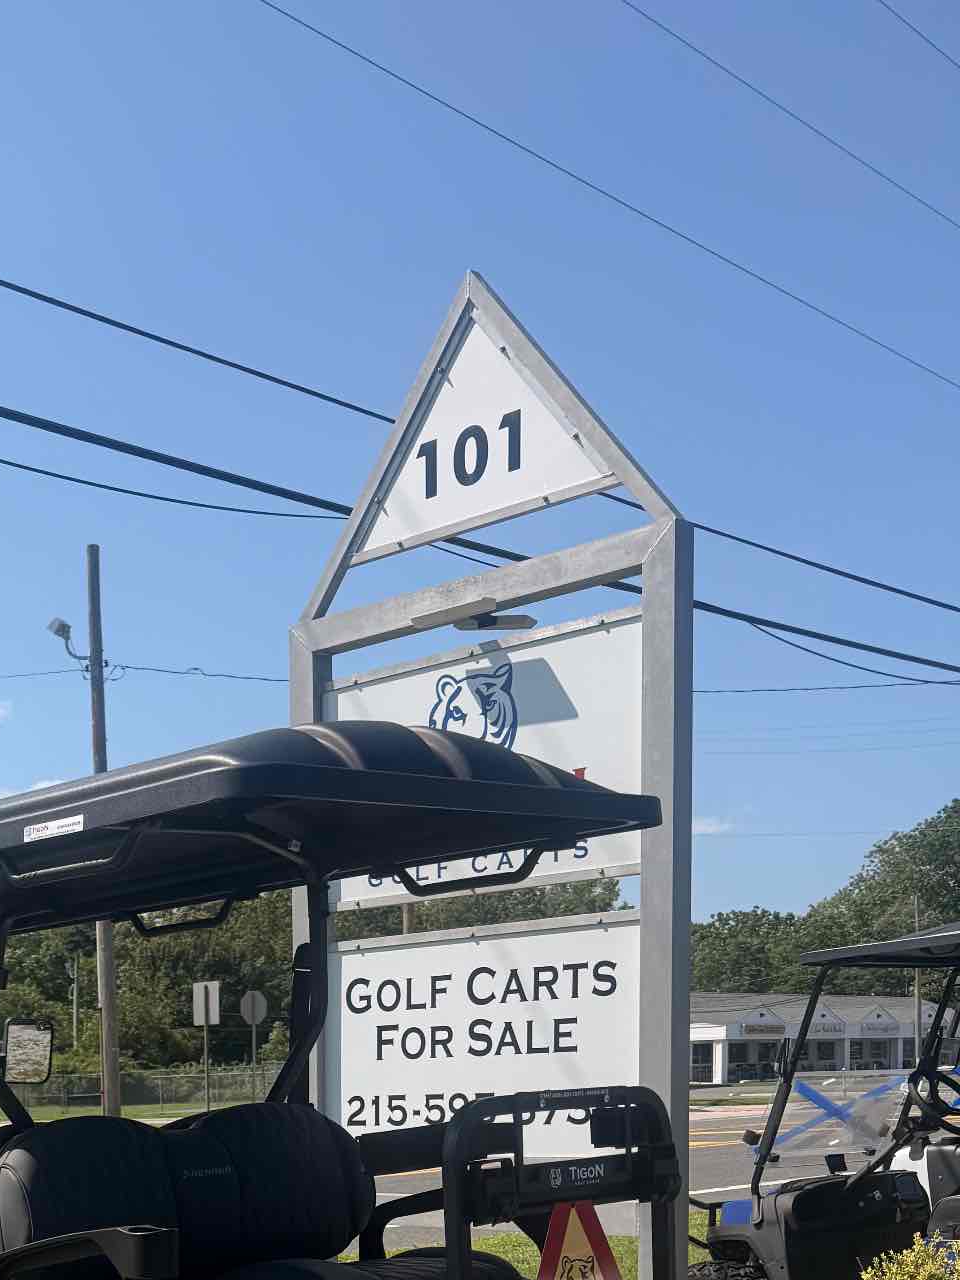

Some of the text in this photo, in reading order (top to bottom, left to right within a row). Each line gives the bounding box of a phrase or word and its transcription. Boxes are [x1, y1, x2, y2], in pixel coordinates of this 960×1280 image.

[415, 408, 522, 500] 101
[471, 839, 589, 874] CAS
[346, 960, 617, 1014] GOLF CARTS
[376, 1017, 578, 1060] FOR SALE
[569, 1164, 604, 1180] TIGON
